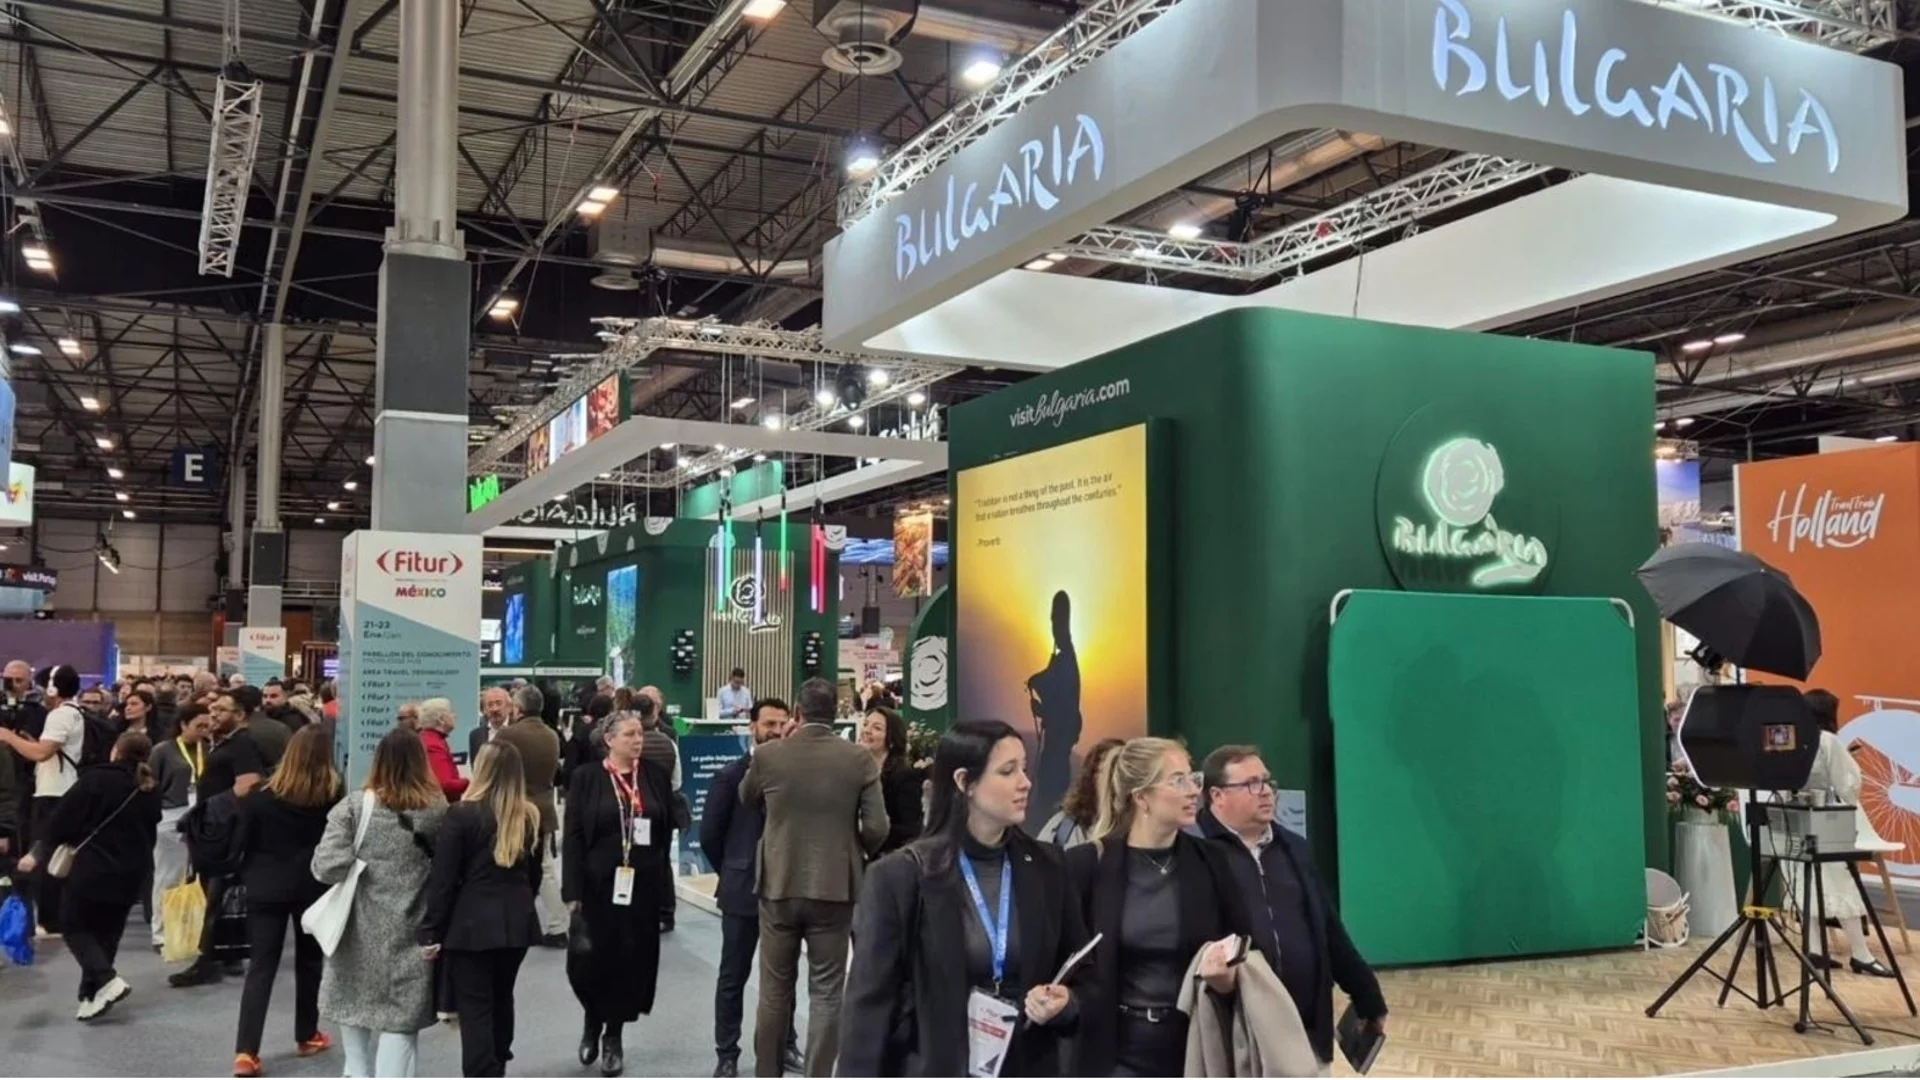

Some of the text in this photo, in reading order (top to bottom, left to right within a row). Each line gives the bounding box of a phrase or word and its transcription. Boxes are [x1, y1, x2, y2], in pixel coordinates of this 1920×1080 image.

[1433, 0, 1839, 174] BULGARIA
[895, 113, 1105, 281] BULGARIA
[184, 453, 204, 482] E
[1767, 483, 1885, 553] Holland
[394, 550, 449, 573] Fitur
[395, 585, 446, 598] MÉXICO
